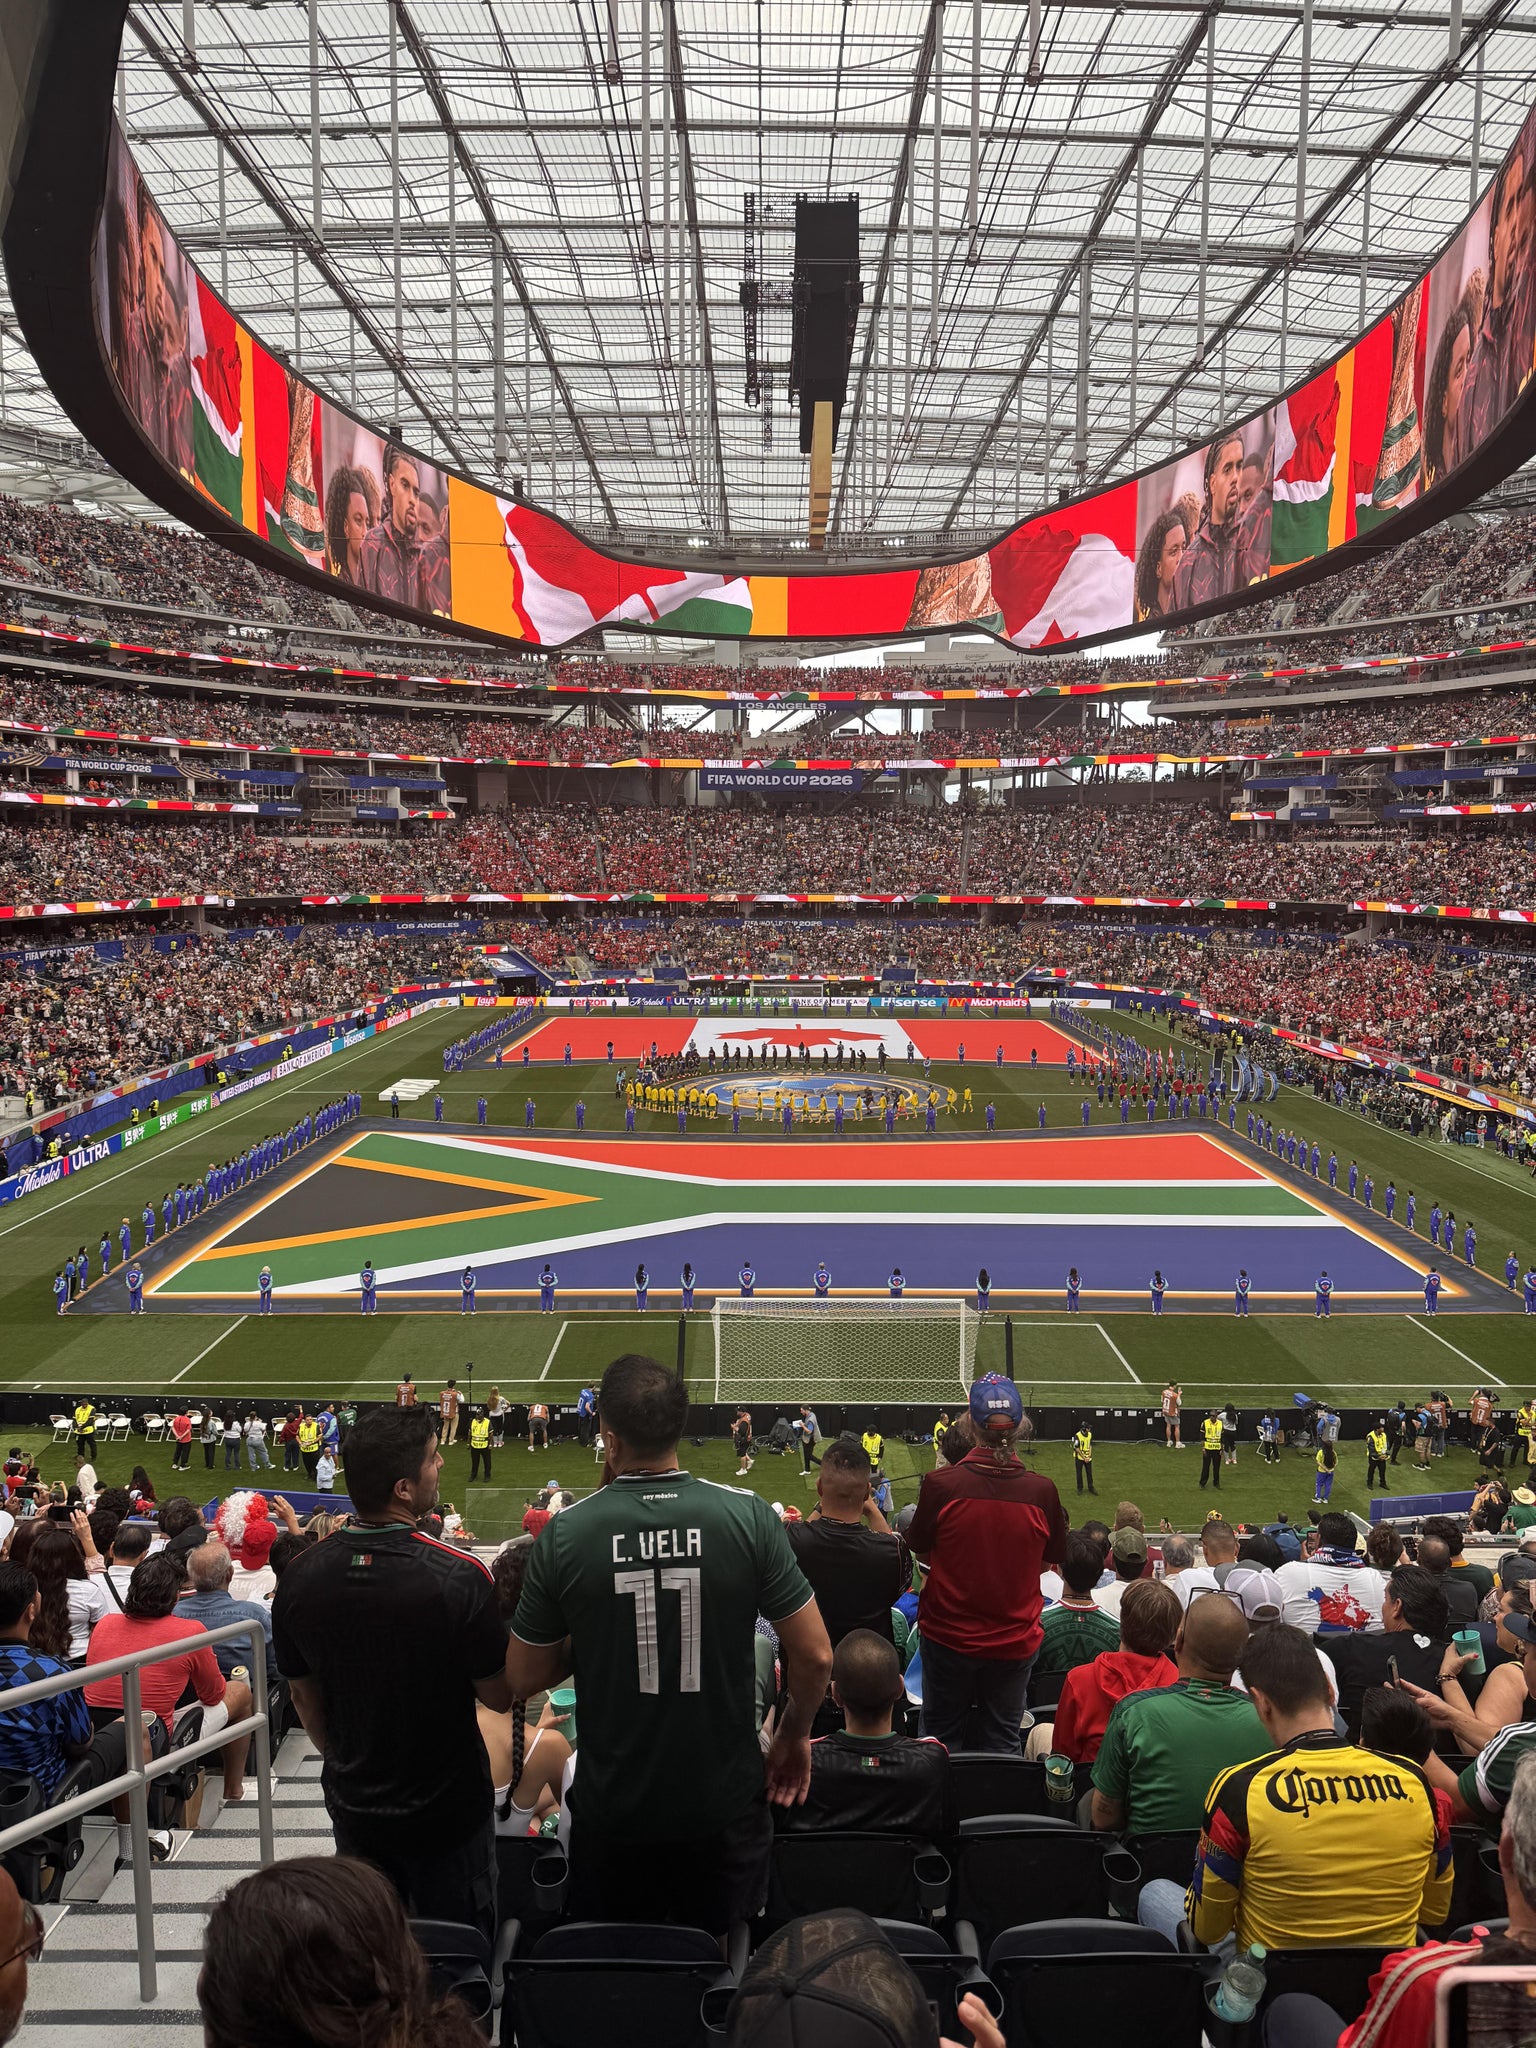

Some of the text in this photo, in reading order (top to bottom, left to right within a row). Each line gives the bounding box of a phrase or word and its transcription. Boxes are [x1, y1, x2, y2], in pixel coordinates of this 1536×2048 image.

[738, 702, 827, 710] LOS ANGELES
[65, 759, 152, 773] FIFA WORLD CUP 2026
[707, 774, 853, 786] FIFA WORLD CUP 2026
[344, 1030, 366, 1048] Hisense
[219, 1088, 235, 1102] UNITED
[234, 1082, 249, 1096] STATES
[254, 1071, 271, 1087] AMERICA
[14, 1141, 110, 1199] Michelob ULTRA
[612, 1528, 702, 1563] C. VELA
[613, 1567, 701, 1695] 11
[1265, 1766, 1409, 1819] Corona
